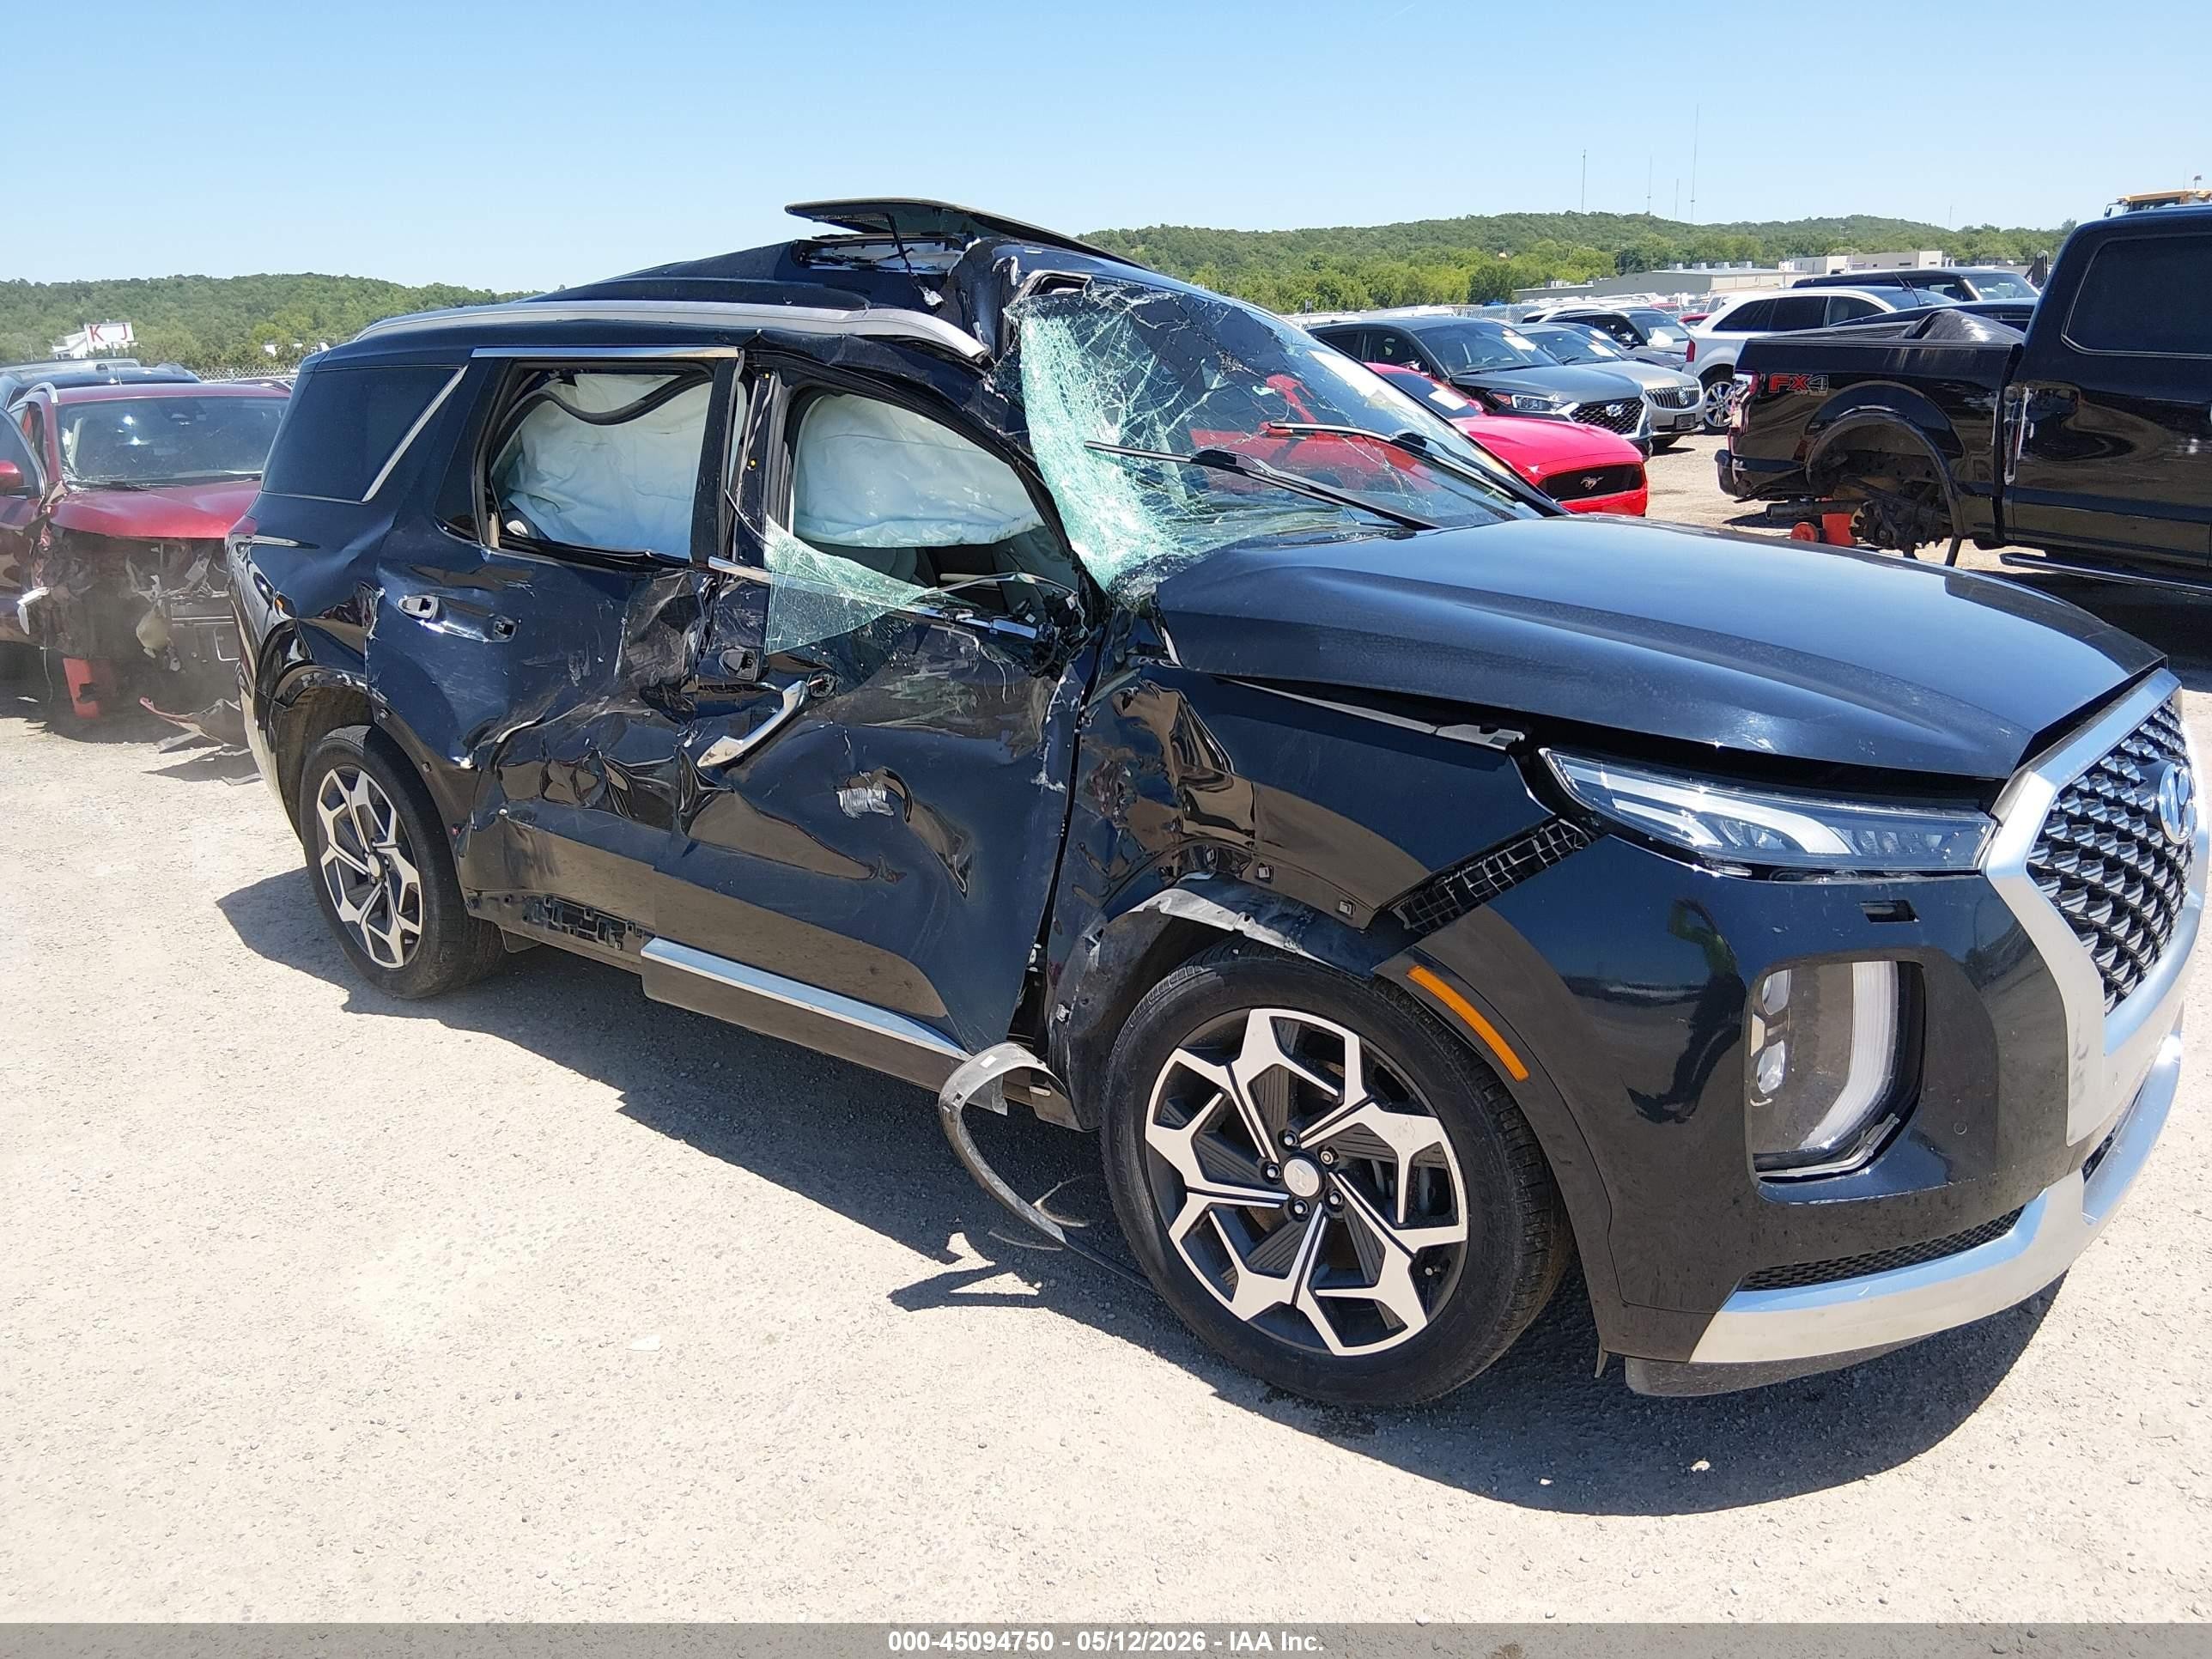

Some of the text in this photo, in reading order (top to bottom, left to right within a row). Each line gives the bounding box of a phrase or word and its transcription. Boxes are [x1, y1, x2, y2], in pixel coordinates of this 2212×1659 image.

[89, 324, 128, 343] K J
[1769, 373, 1828, 392] FX4
